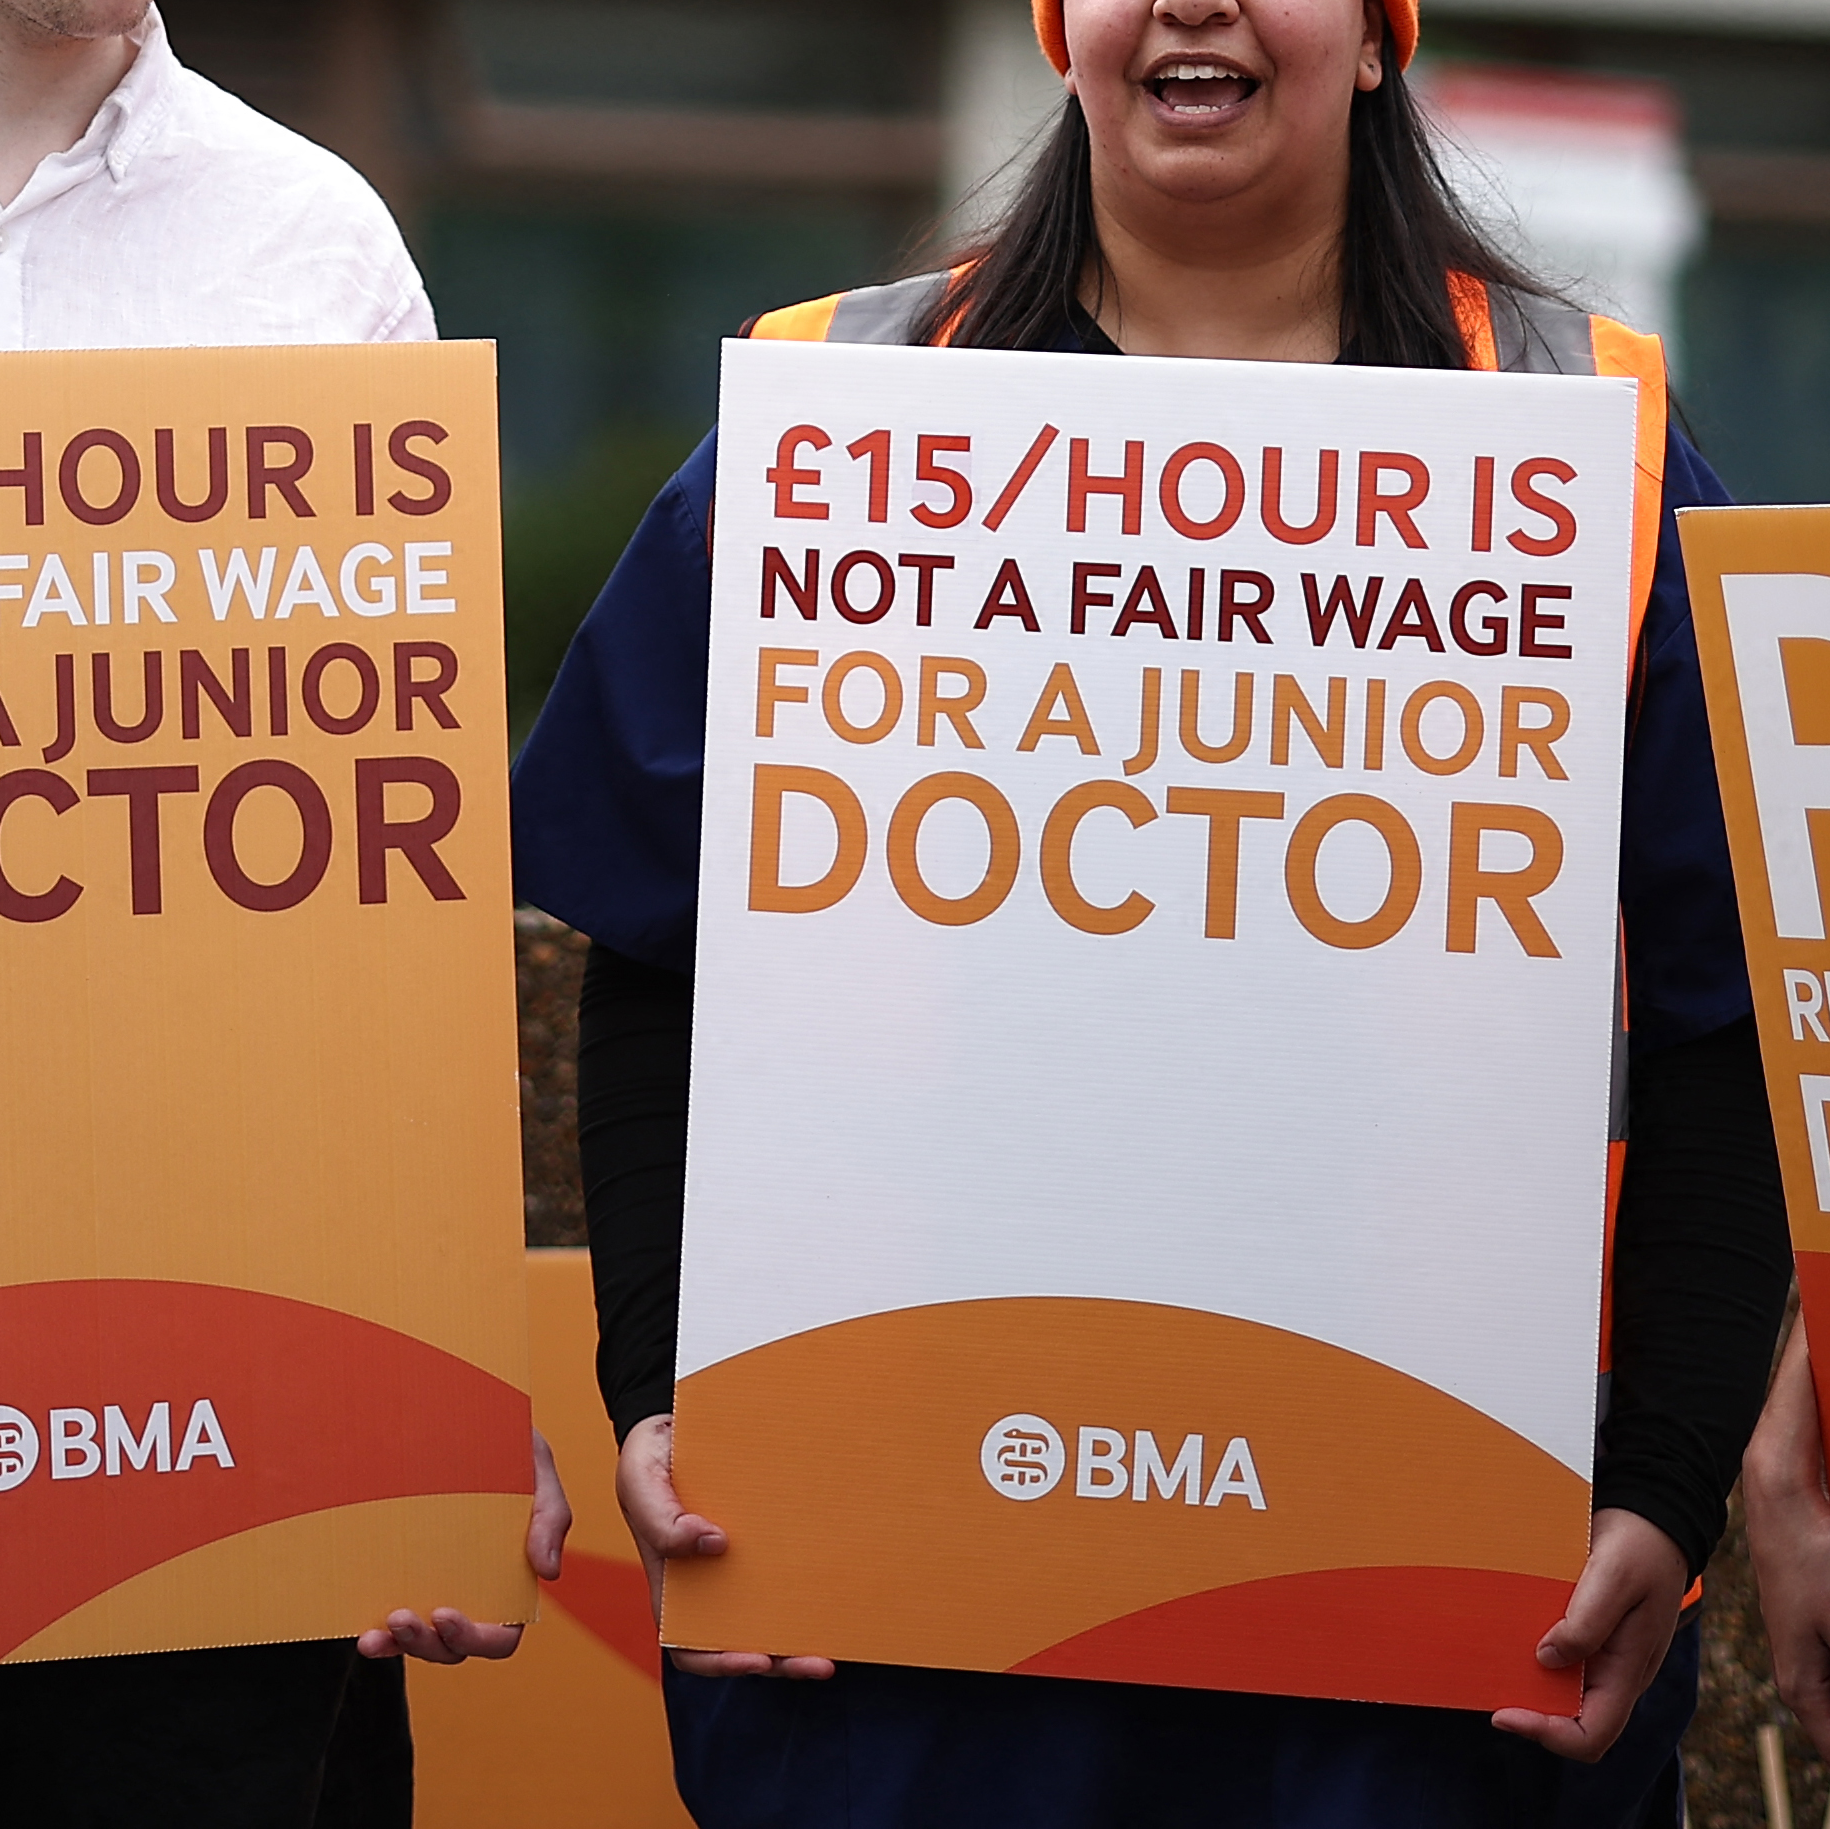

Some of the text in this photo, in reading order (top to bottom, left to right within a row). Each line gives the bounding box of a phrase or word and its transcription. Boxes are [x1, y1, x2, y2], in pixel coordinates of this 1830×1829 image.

[354, 421, 452, 516] IS
[766, 423, 1578, 556] £15/HOUR IS
[199, 542, 456, 620] WAGE
[761, 546, 1573, 659] NOT A FAIR WAGE
[43, 642, 461, 764] JUNIOR
[755, 647, 1570, 781] FOR A JUNIOR
[748, 763, 1563, 959] DOCTOR
[50, 1400, 234, 1476] BMA
[1076, 1427, 1266, 1510] BMA
